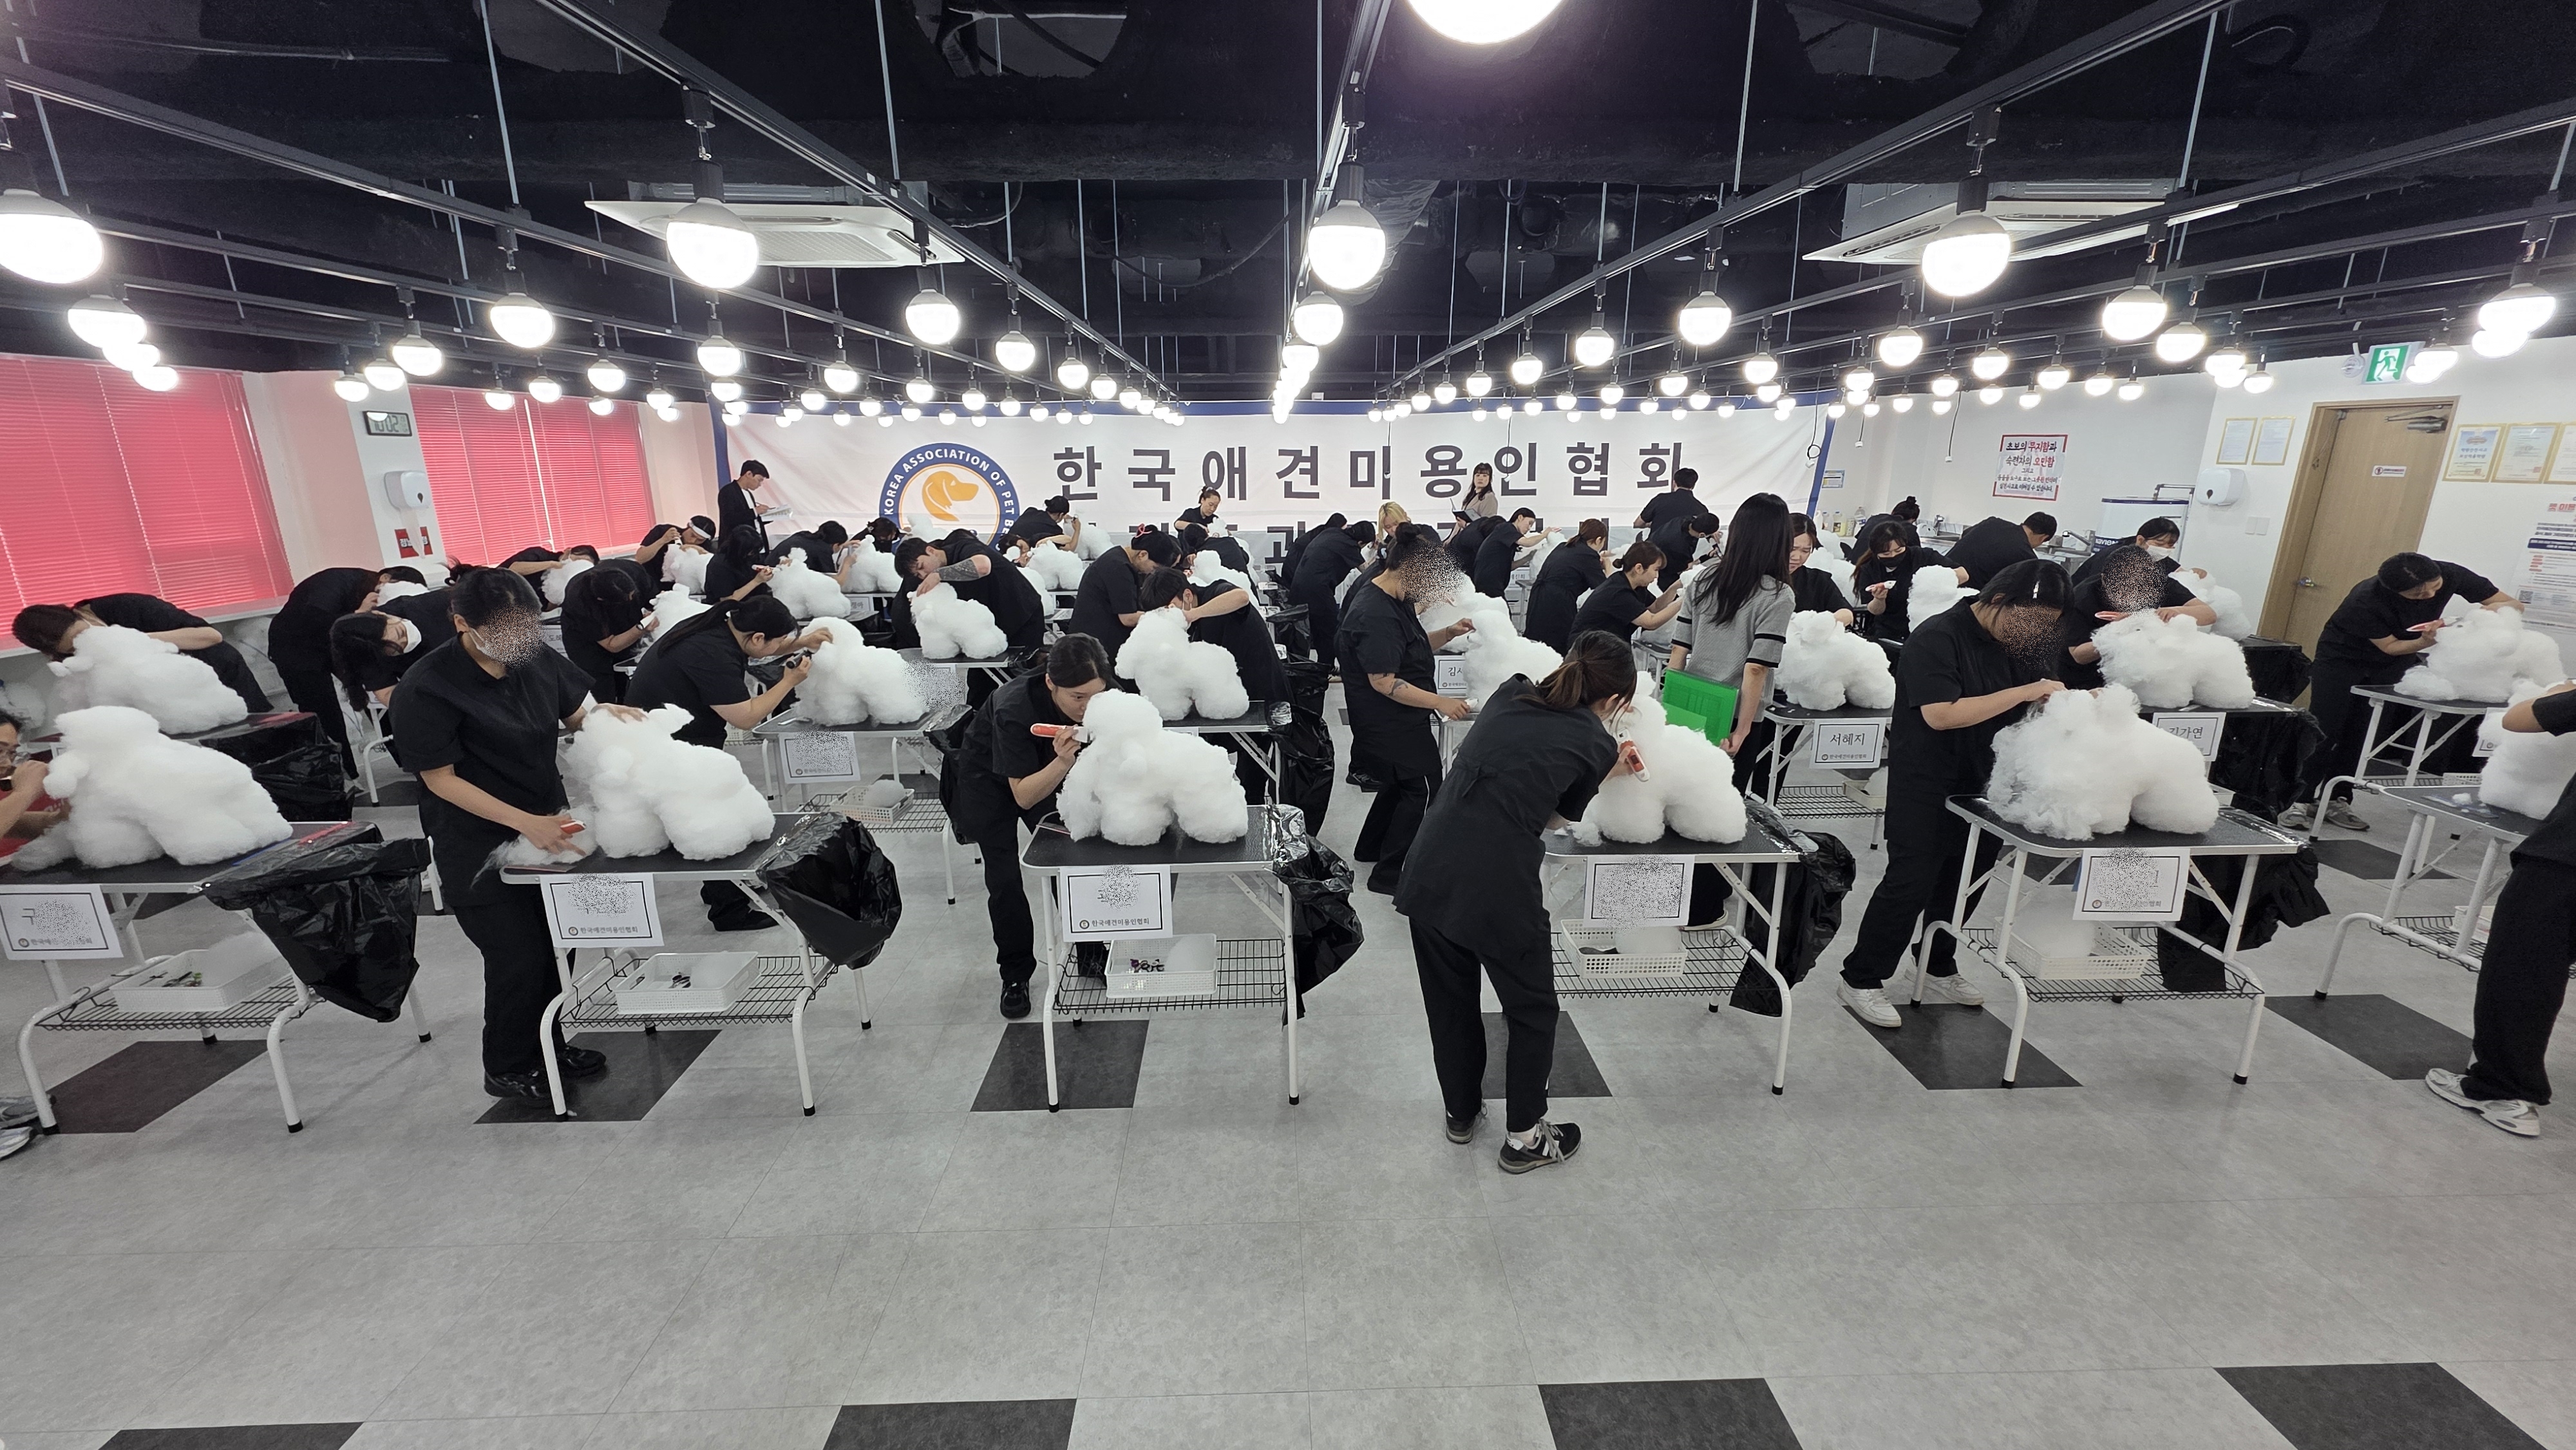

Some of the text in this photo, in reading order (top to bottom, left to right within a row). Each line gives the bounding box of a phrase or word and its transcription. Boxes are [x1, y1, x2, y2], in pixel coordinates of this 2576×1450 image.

[2005, 440, 2057, 453] 초보의 무지함과
[2005, 455, 2054, 467] 숙련자의 오만함
[1054, 442, 1681, 502] 한국애견미용인협회
[884, 448, 1015, 515] KOREA ASSOCIATION OF PET
[1830, 733, 1865, 746] 서혜지
[1092, 918, 1150, 927] 한국애견미용인협회
